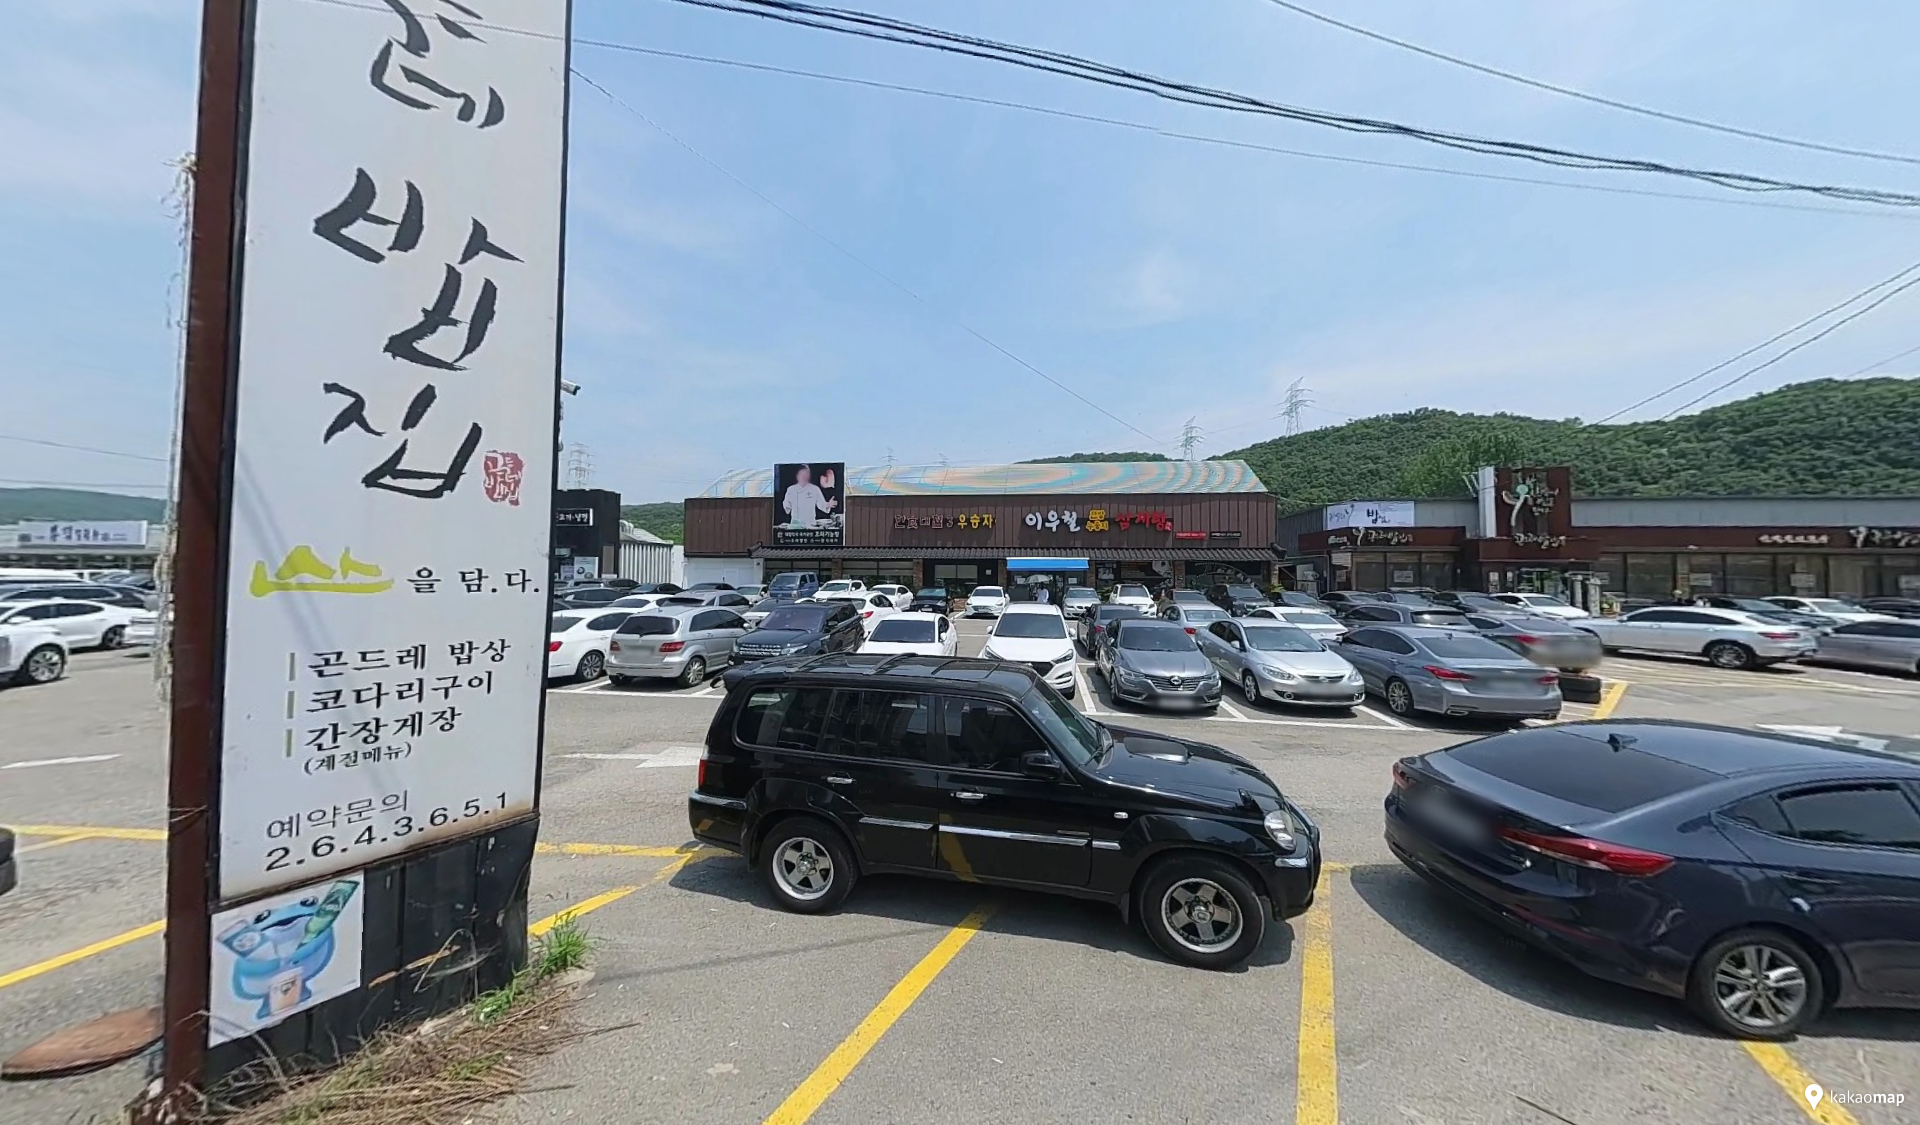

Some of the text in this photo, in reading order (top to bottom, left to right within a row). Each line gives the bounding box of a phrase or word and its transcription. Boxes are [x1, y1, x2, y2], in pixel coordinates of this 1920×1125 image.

[957, 514, 993, 529] 우승자
[1025, 510, 1080, 532] 이우철
[308, 639, 512, 678] 곤드레 밥상
[306, 671, 493, 713] 코다리구이
[304, 706, 463, 752] 간장게장
[265, 793, 507, 871] 2.6.4.3.6.5.1
[266, 790, 408, 839] 예약문의
